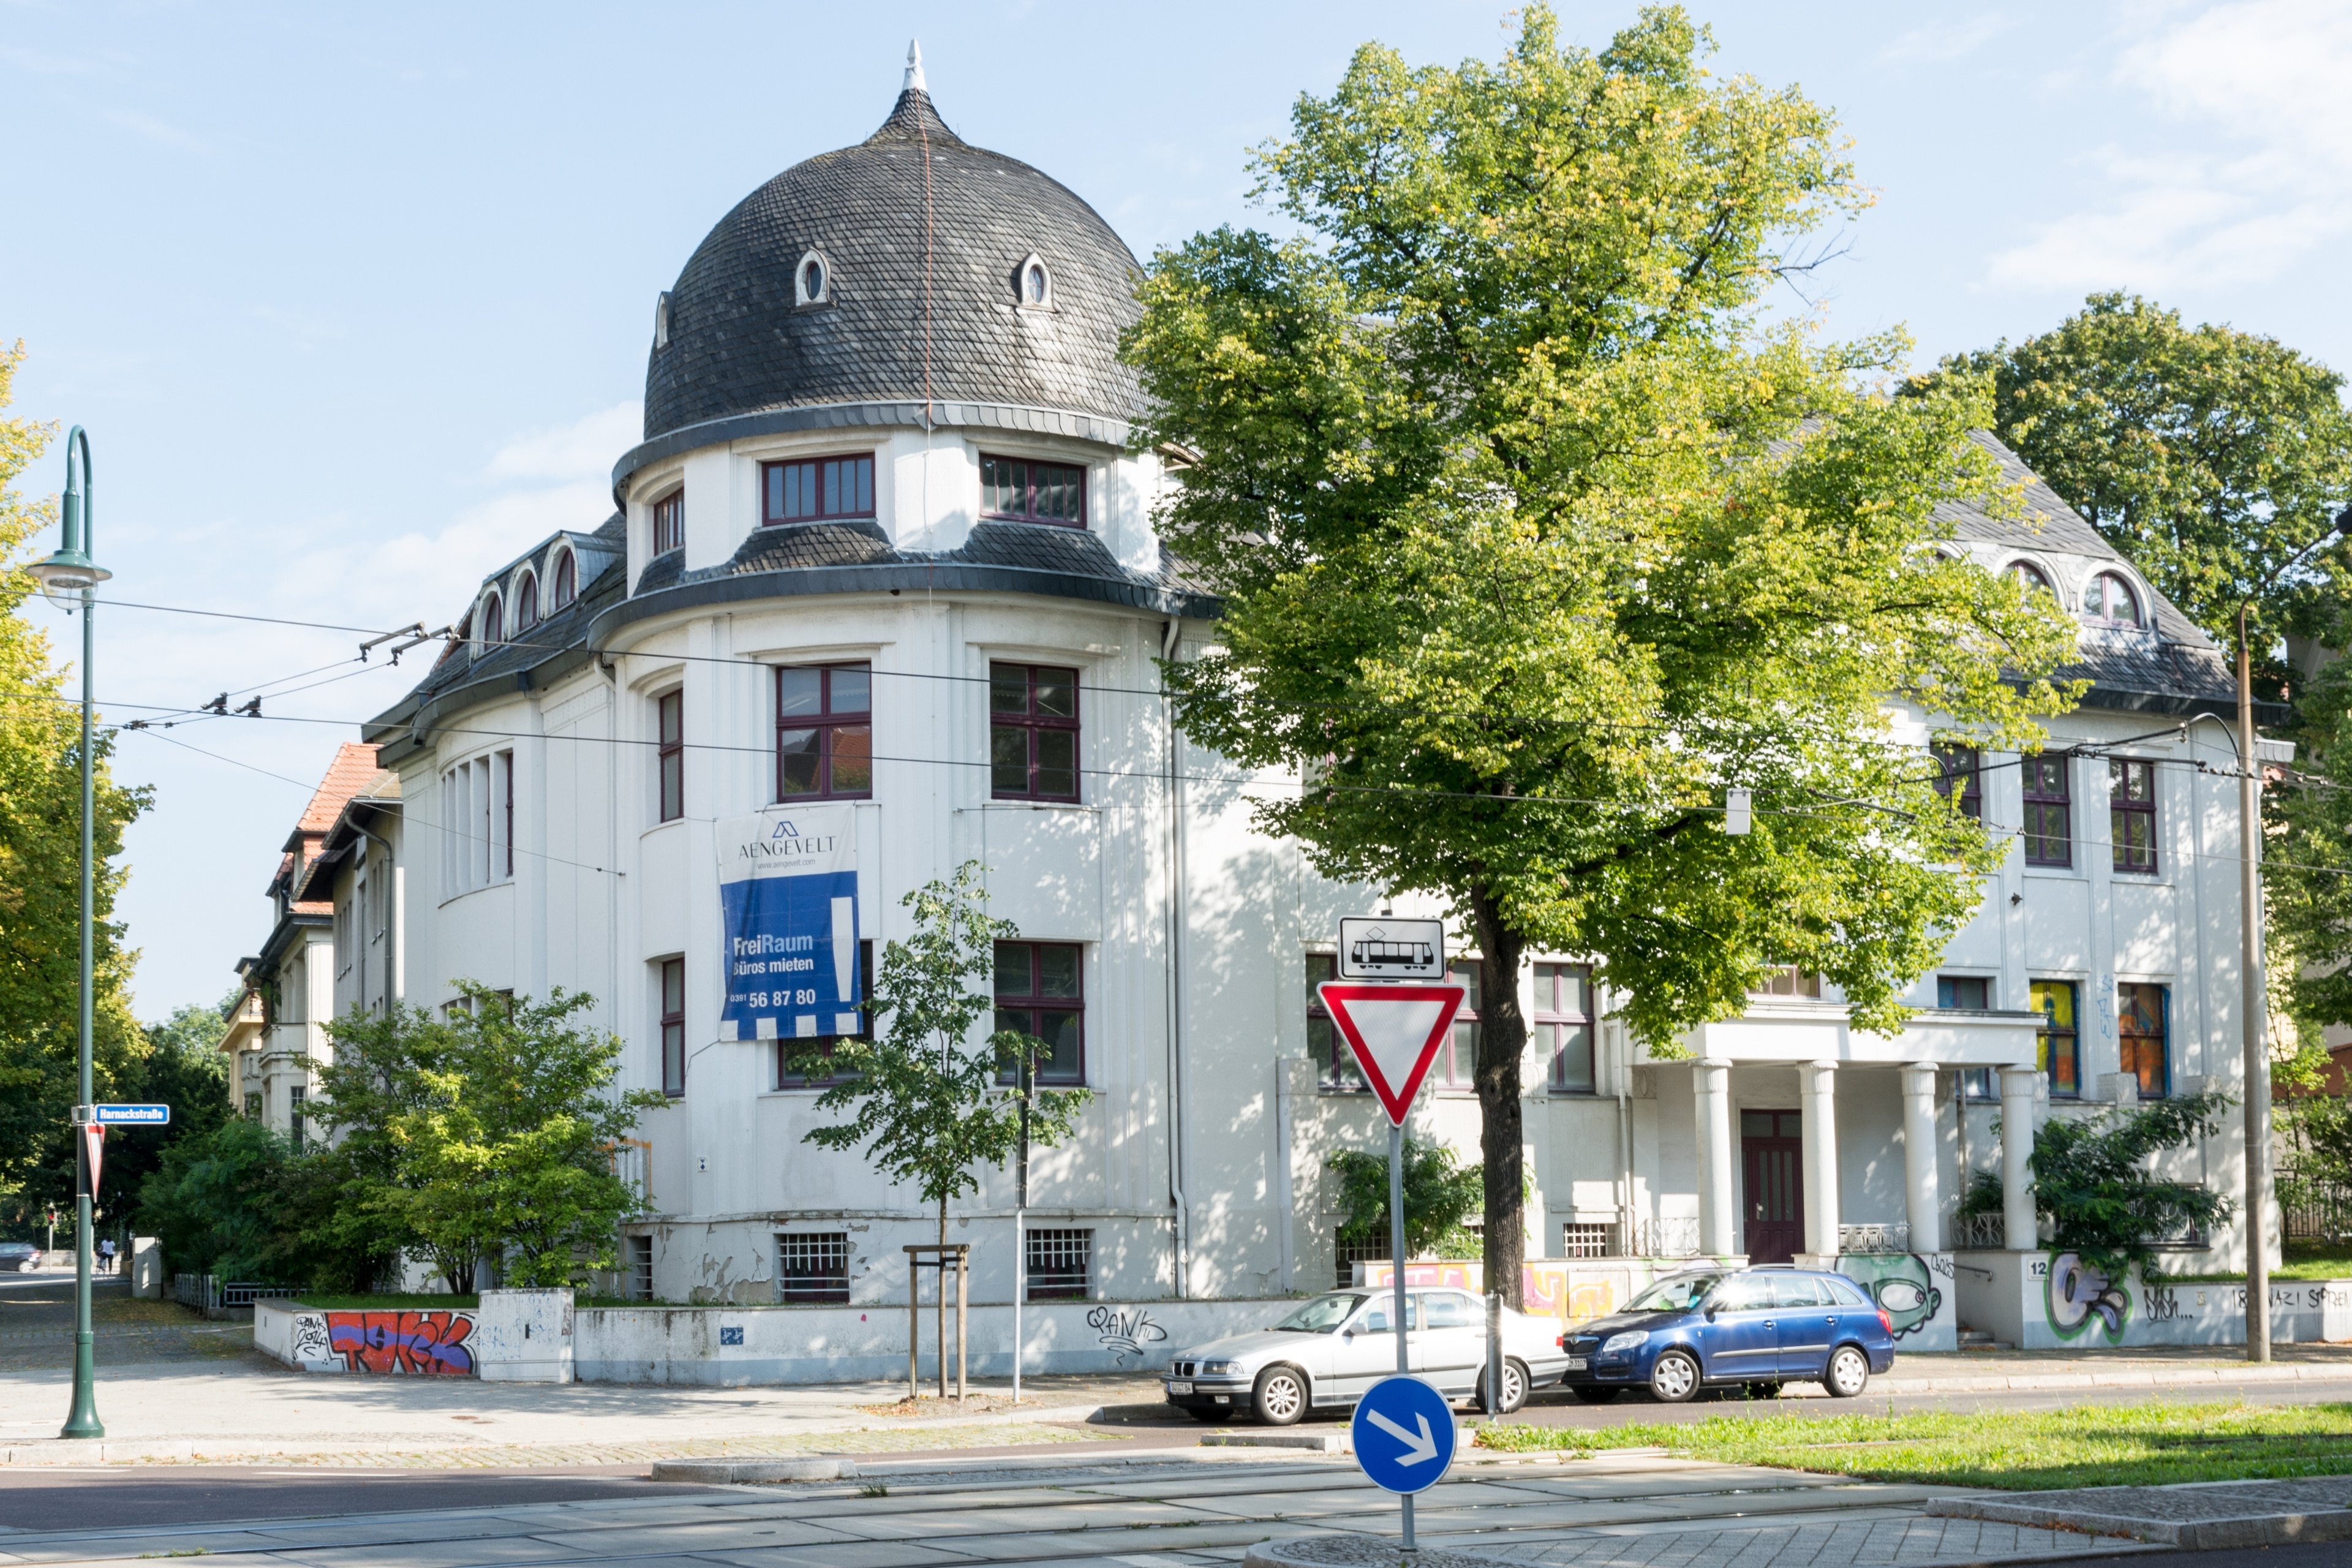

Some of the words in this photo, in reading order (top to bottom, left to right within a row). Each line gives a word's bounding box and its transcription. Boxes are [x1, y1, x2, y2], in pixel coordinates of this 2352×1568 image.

[739, 836, 836, 860] AENGEVELT
[757, 859, 815, 870] www.aengevelt.com
[734, 934, 813, 956] FreiRaum
[733, 960, 766, 976] Büros
[769, 957, 813, 973] mieten
[749, 992, 767, 1008] 56
[772, 990, 791, 1006] 87
[796, 989, 816, 1005] 80
[100, 1108, 163, 1120] Harnackstraße
[2030, 1262, 2047, 1275] 12
[1574, 1359, 1586, 1368] 3107
